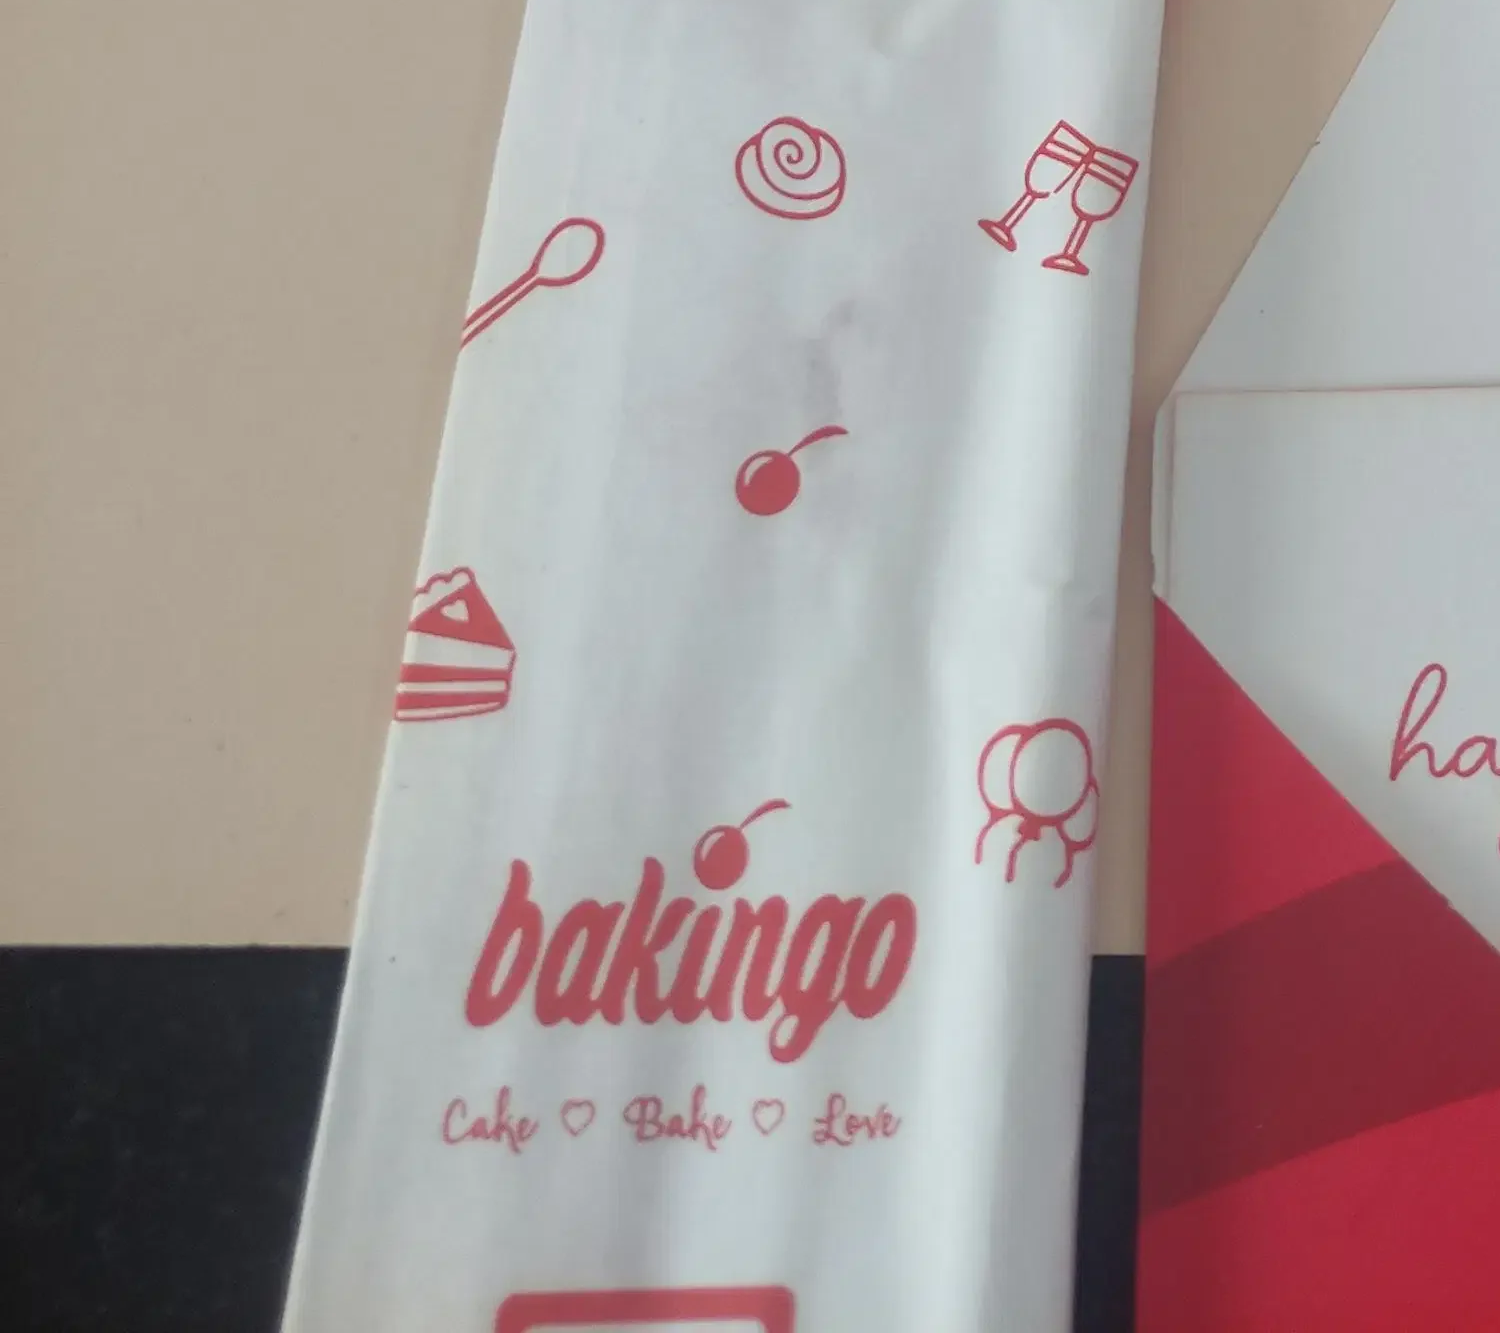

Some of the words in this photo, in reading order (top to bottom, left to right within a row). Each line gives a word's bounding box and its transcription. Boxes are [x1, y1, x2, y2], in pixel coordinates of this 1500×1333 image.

[464, 824, 918, 1064] bakingo
[441, 1085, 541, 1155] Cake
[621, 1084, 733, 1152] Bake
[812, 1091, 903, 1148] Love
